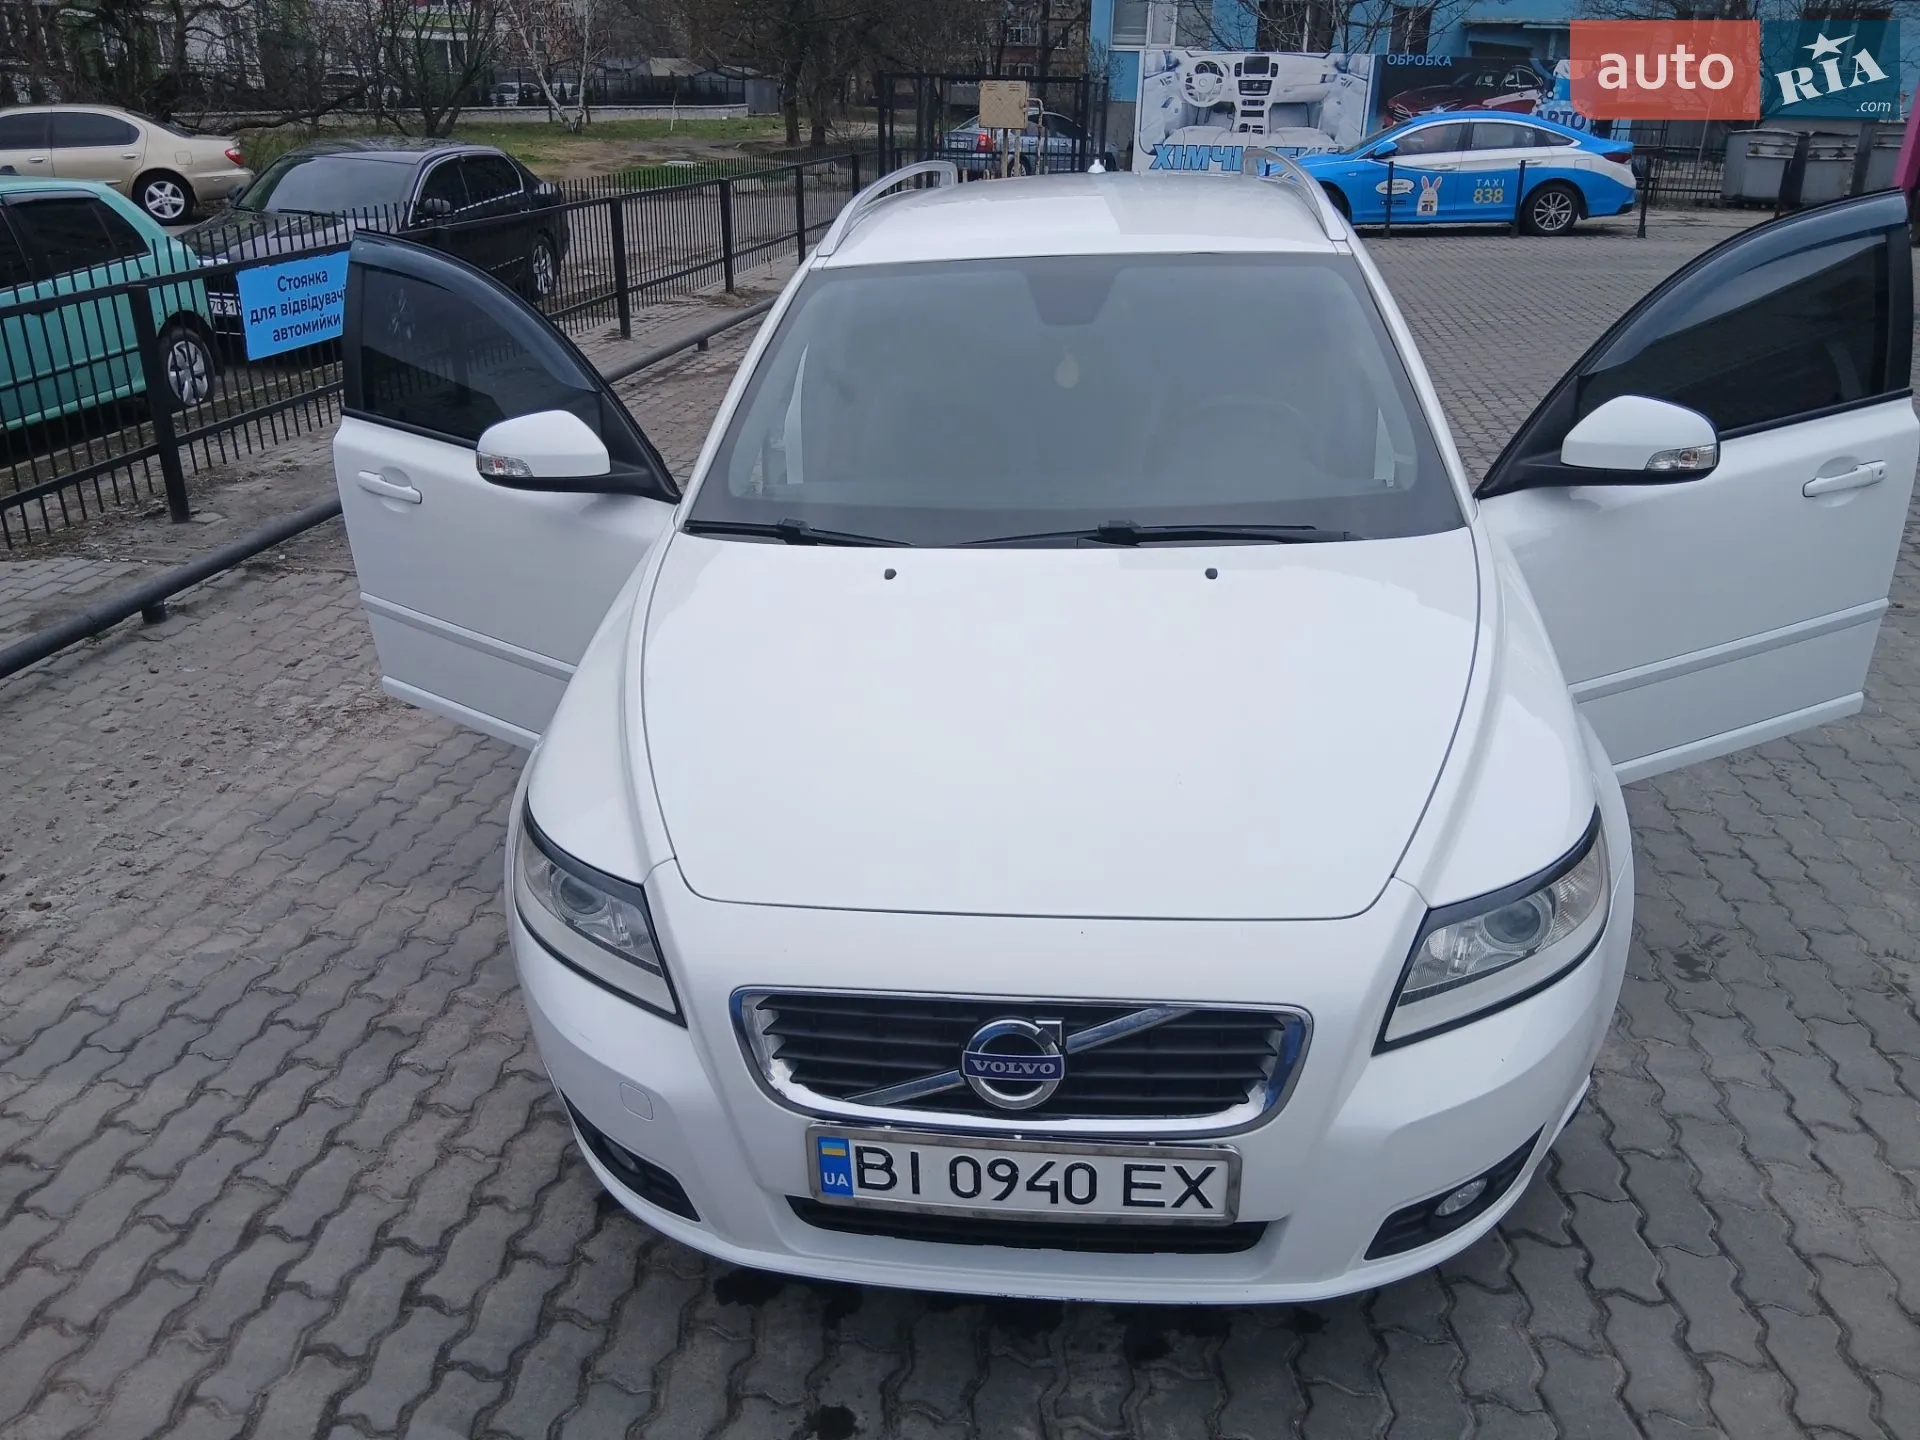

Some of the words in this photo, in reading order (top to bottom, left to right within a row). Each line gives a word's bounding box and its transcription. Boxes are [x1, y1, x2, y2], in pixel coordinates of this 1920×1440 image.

[1386, 54, 1452, 67] ОБРОБКА
[1476, 178, 1505, 188] TAXI
[1473, 188, 1504, 204] 838
[277, 269, 329, 292] Стоянка
[250, 305, 277, 326] для
[272, 313, 341, 342] автомийки
[969, 1058, 1057, 1077] VOLVO
[823, 1171, 849, 1188] UA
[855, 1146, 921, 1195] BI
[949, 1155, 1098, 1205] 0940
[1122, 1163, 1217, 1209] EX
